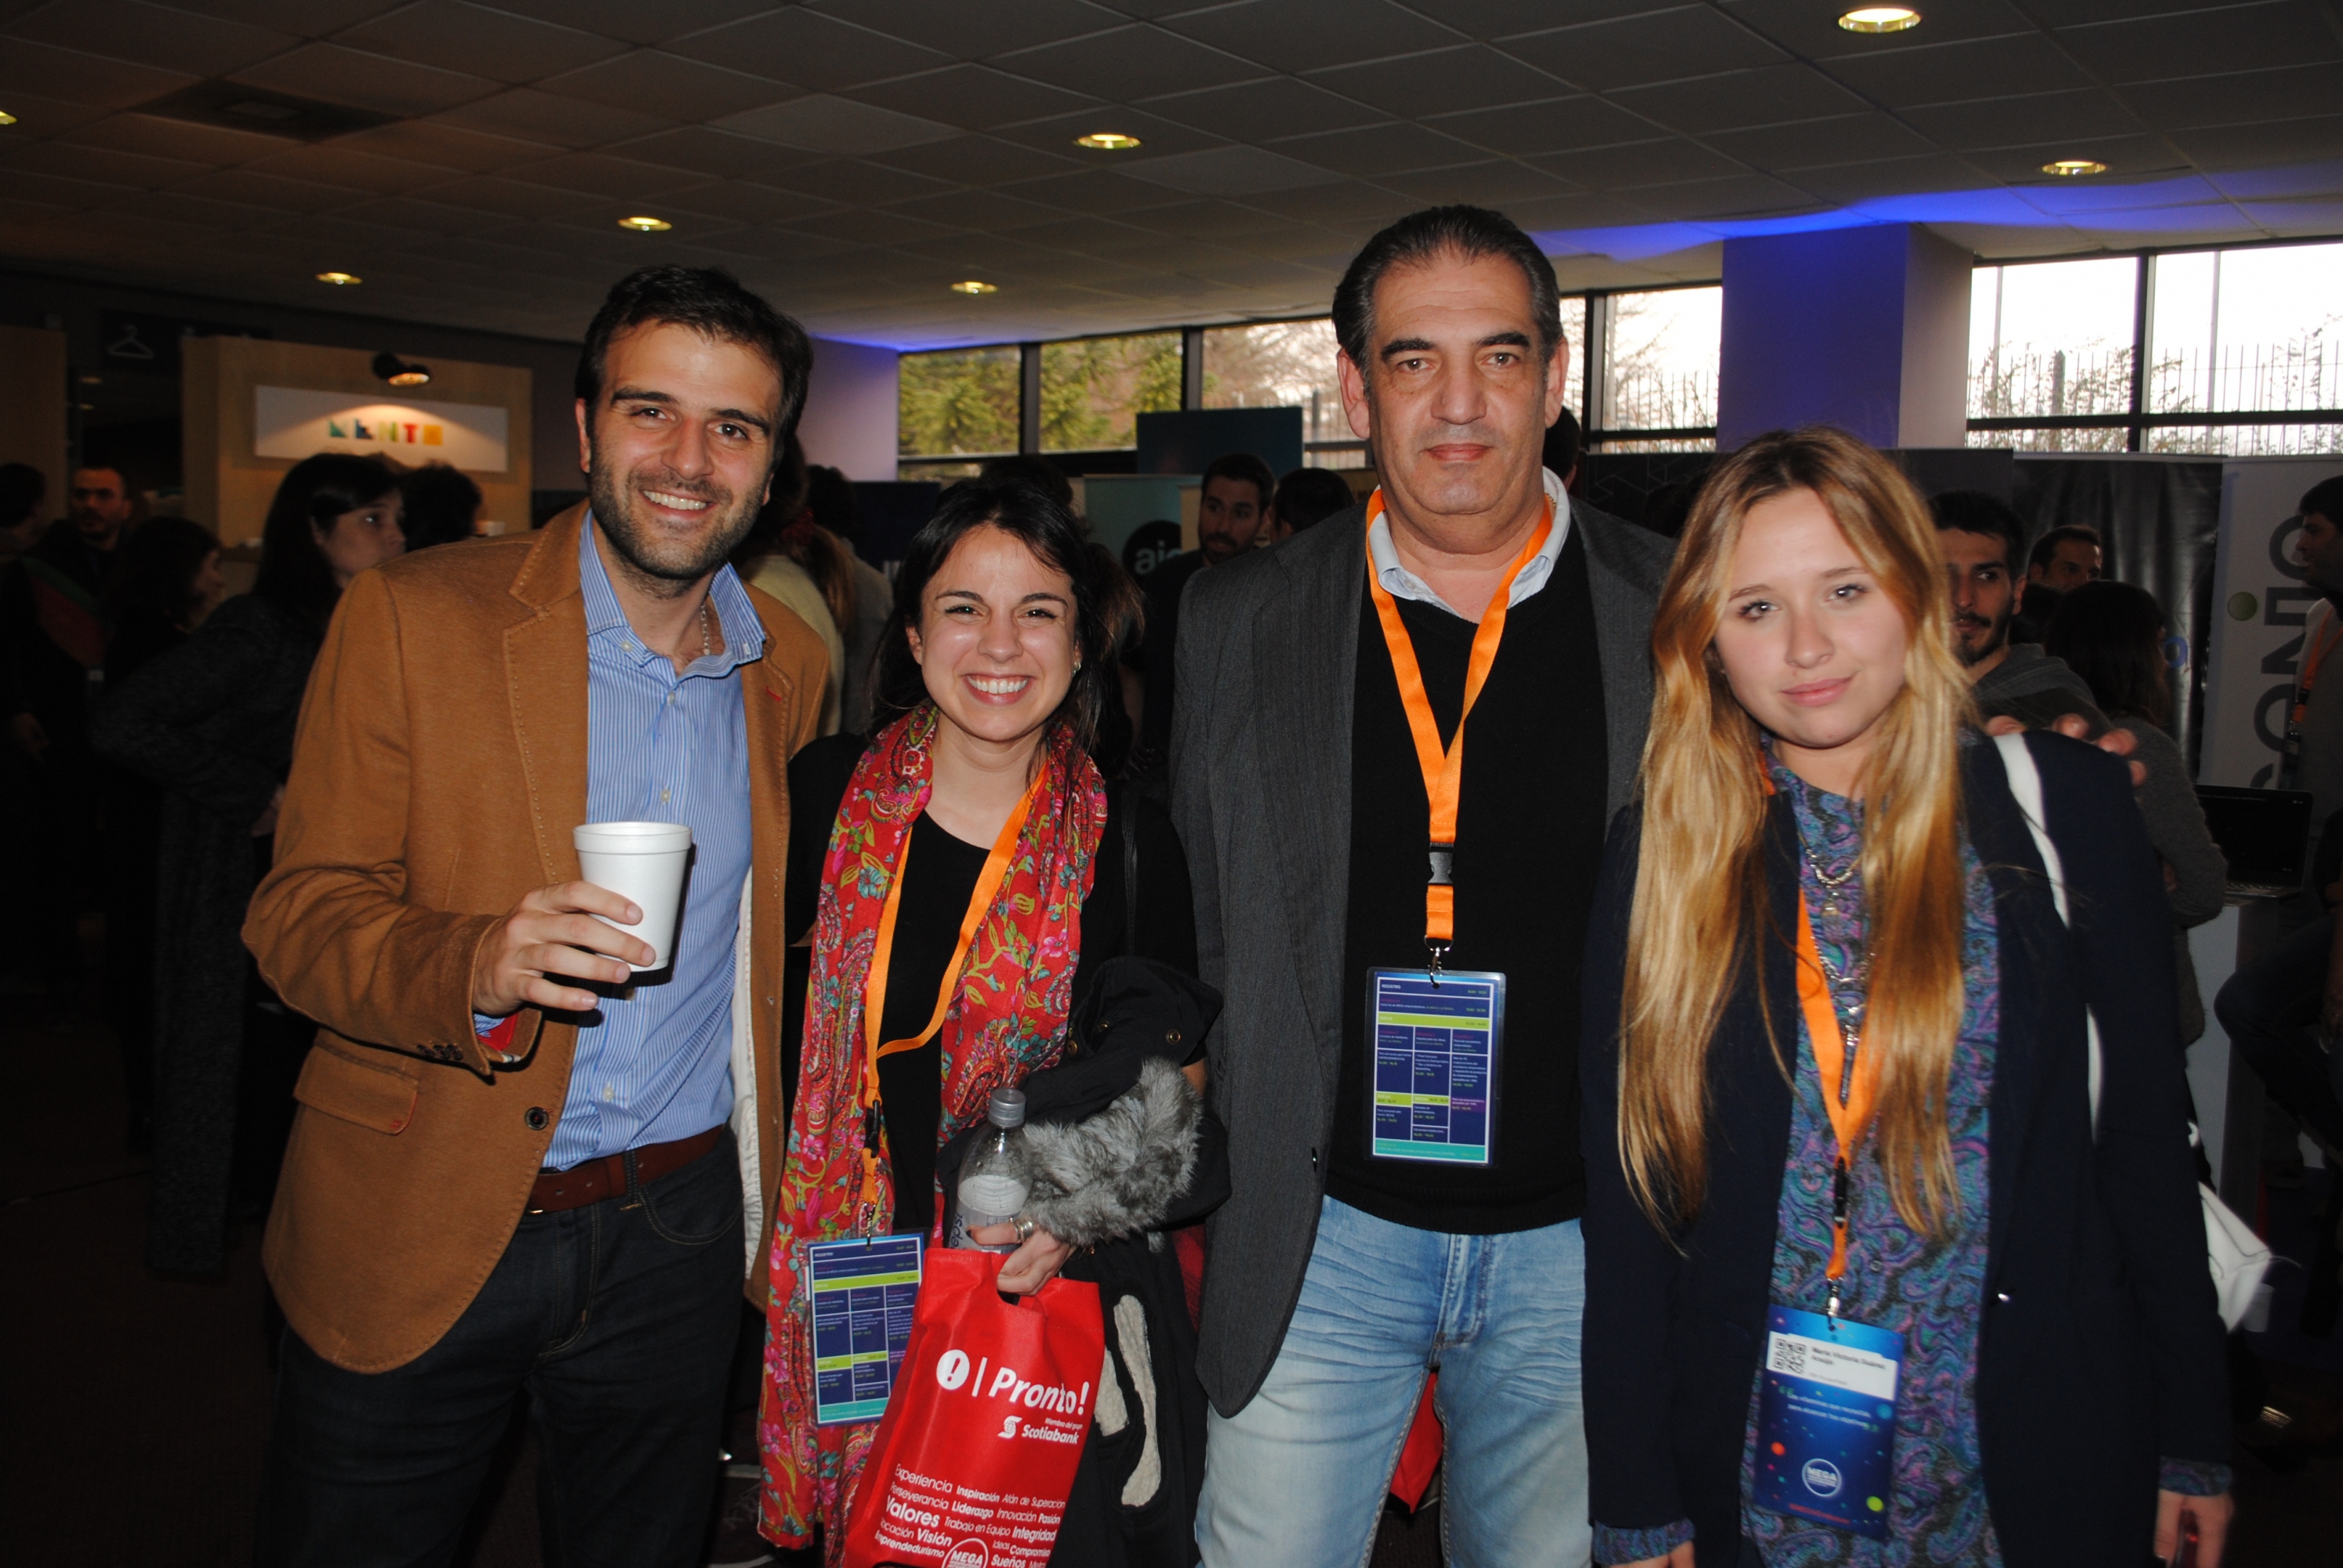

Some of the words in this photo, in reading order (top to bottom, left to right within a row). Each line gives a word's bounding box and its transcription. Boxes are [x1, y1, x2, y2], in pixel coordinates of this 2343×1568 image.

[950, 1212, 964, 1249] epsi
[988, 1367, 1090, 1415] Pronto!
[1021, 1424, 1080, 1444] Scotiabank
[895, 1463, 954, 1494] Experiencia
[956, 1484, 1001, 1503] Inspiración
[1019, 1496, 1030, 1506] de
[1030, 1496, 1066, 1509] Superación
[885, 1494, 940, 1528] Valores
[944, 1515, 975, 1533] Trabajo
[975, 1524, 986, 1533] en
[986, 1524, 1012, 1537] Equipo
[1012, 1526, 1058, 1543] Integridad
[951, 1500, 994, 1520] Liderazgo
[996, 1508, 1037, 1522] Innovación
[1037, 1512, 1061, 1524] Pasión
[917, 1527, 953, 1547] Visión
[950, 1550, 983, 1565] MEGA
[992, 1540, 1010, 1550] Ideas
[1009, 1544, 1051, 1558] Compromiso
[991, 1554, 1026, 1568] Sueños
